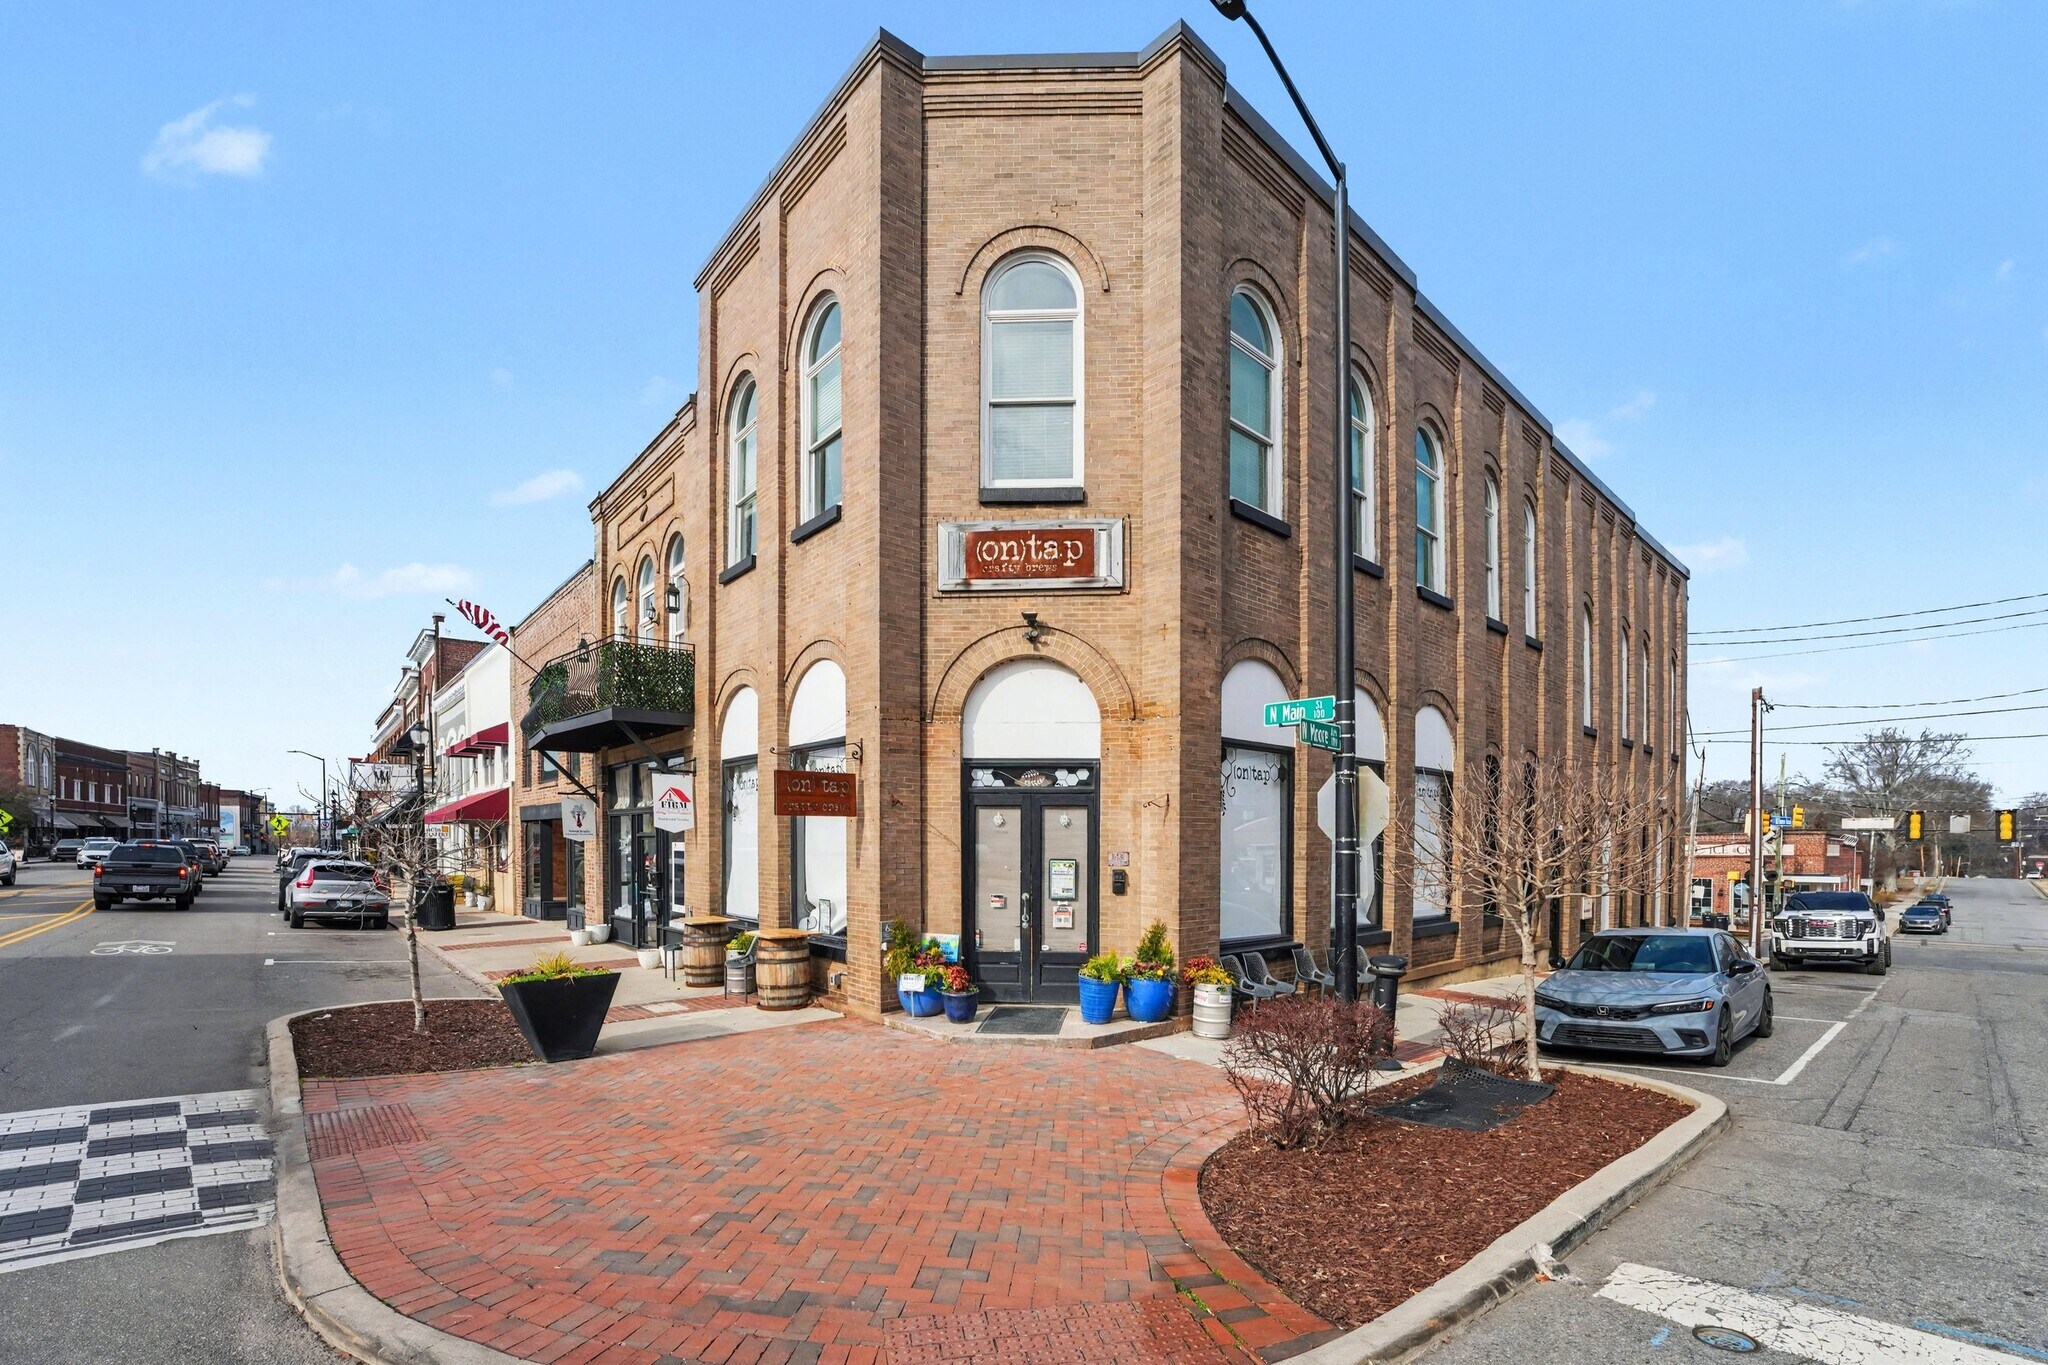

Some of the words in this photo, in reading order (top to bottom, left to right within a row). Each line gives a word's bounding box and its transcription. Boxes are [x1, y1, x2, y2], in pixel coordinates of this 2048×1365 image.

[976, 534, 1084, 567] (on)tap
[1025, 562, 1058, 573] brews
[1269, 706, 1277, 723] N
[1282, 703, 1306, 721] Main
